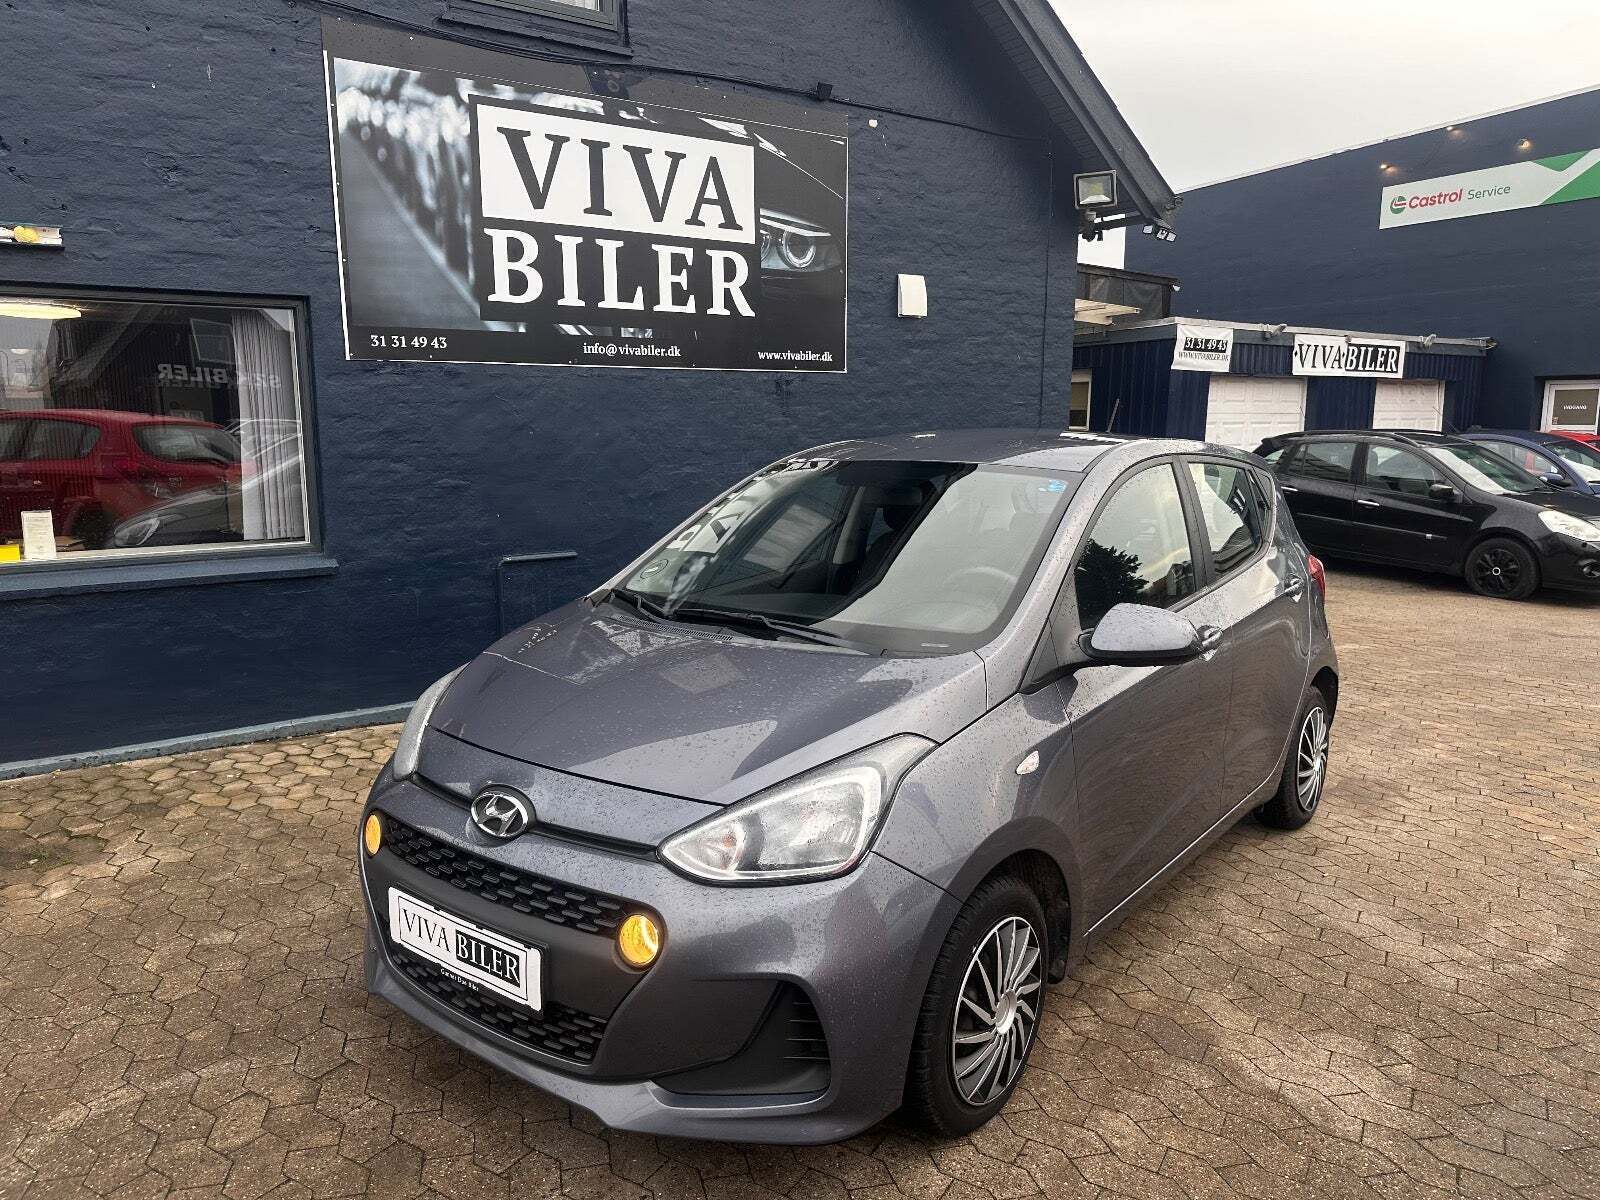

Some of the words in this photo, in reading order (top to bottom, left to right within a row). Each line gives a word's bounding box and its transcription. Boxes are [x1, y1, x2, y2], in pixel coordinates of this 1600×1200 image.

[496, 126, 744, 231] VIVA
[1408, 188, 1463, 209] Castrol
[1467, 185, 1511, 200] Service
[483, 227, 756, 317] BILER
[370, 334, 387, 347] 31
[391, 335, 407, 348] 31
[411, 336, 428, 348] 49
[430, 336, 447, 349] 43
[583, 342, 681, 357] info@vivabiler.dk
[1185, 337, 1195, 349] 31
[1196, 338, 1206, 349] 31
[1207, 339, 1217, 350] 49
[1217, 340, 1227, 351] 43
[757, 350, 833, 362] www.vivabiler.dk
[1297, 343, 1343, 369] VIVA
[1345, 346, 1398, 372] BILER
[402, 908, 451, 953] VIVA
[456, 933, 521, 984] BILER
